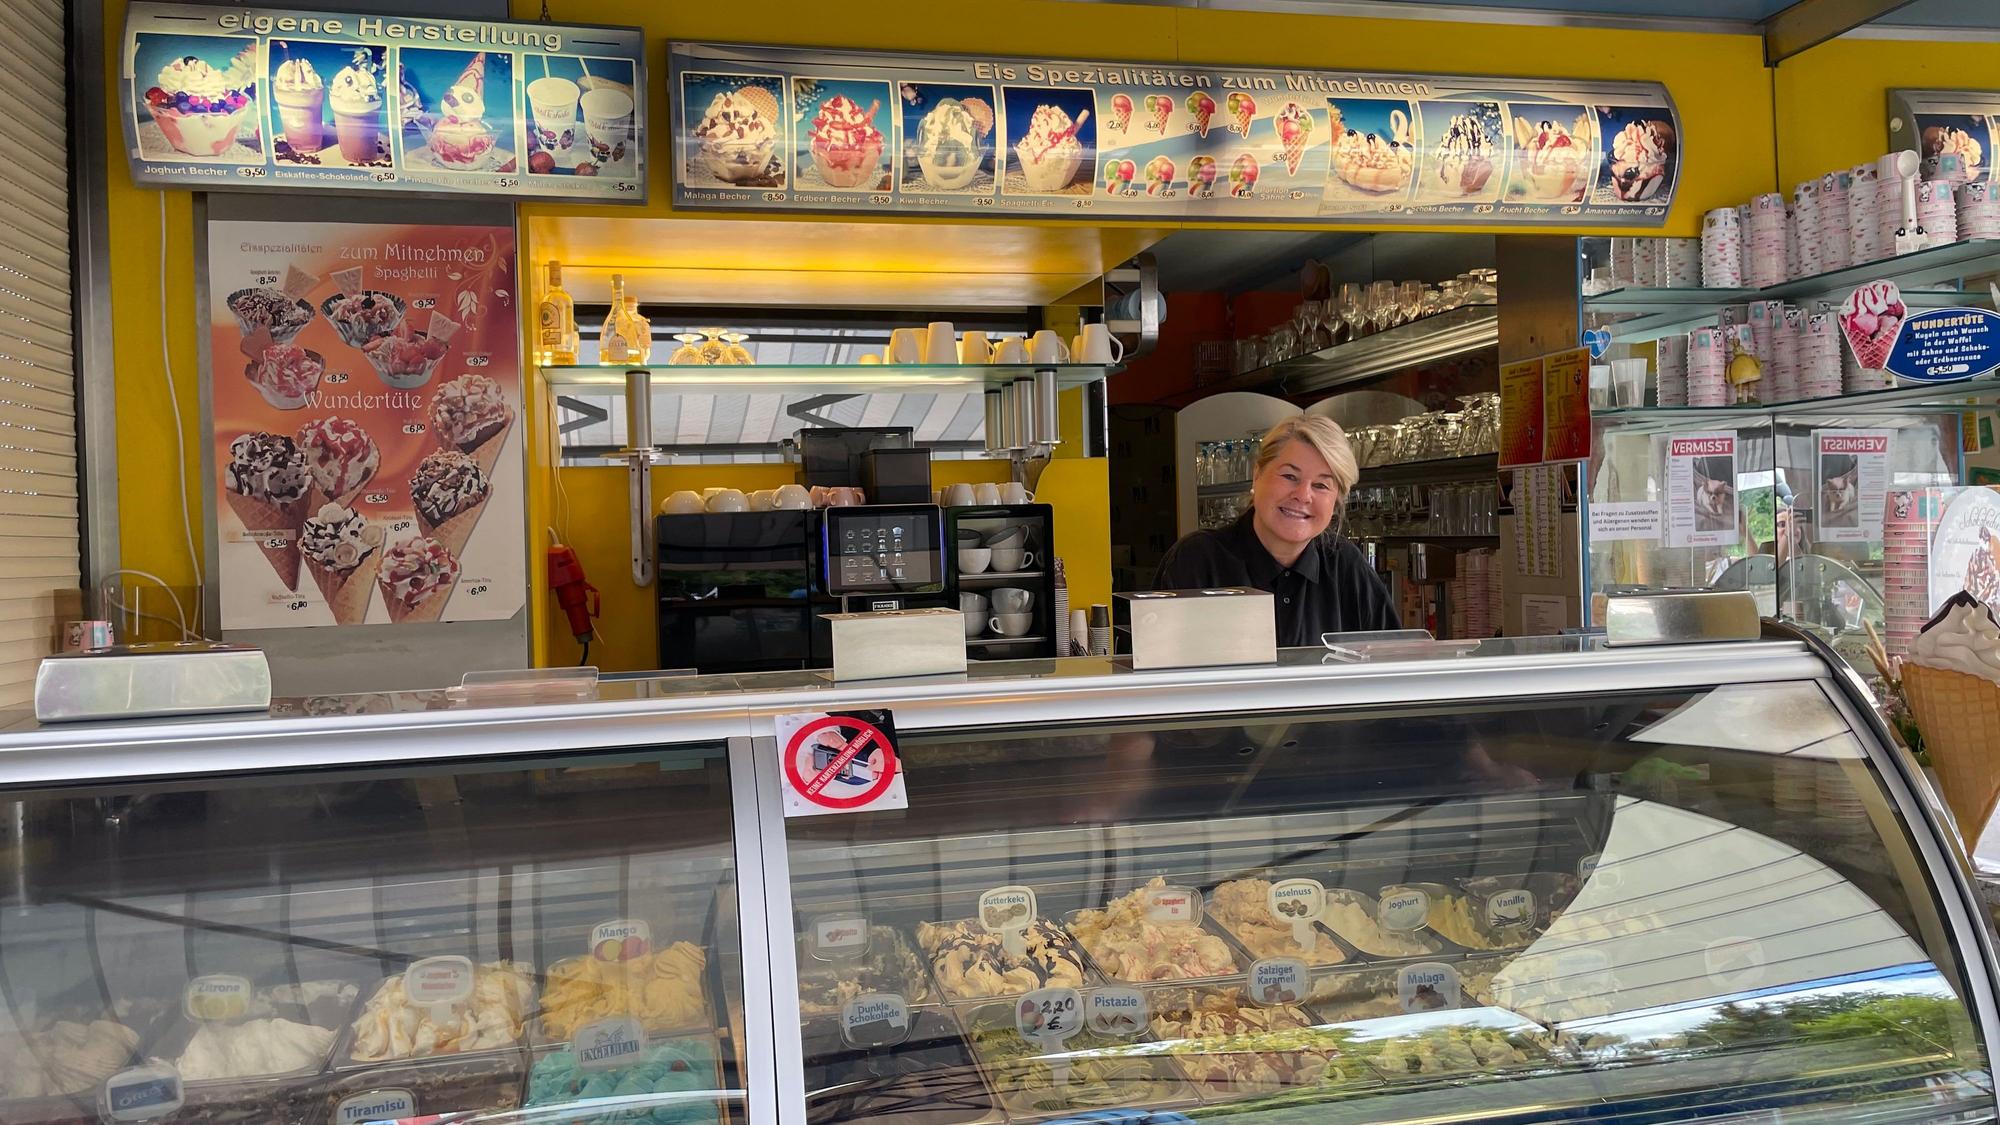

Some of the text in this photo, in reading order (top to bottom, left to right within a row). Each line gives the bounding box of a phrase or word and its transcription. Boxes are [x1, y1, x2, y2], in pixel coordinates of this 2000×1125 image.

[217, 11, 563, 52] eigene Herstellung
[973, 63, 1430, 95] Eis Spezialitäten zum Mitnehmen
[144, 165, 187, 177] Joghurt
[189, 166, 228, 176] Becher
[684, 191, 717, 201] Malaga
[719, 192, 751, 201] Becher
[794, 194, 828, 203] Erdbeer
[830, 195, 861, 204] Becher
[899, 197, 917, 205] Kiwi
[1499, 206, 1523, 214] Frucht
[1585, 207, 1616, 215] Amarena
[1618, 207, 1642, 215] Becher
[340, 246, 377, 260] zum
[385, 243, 485, 263] Mitnehmen
[375, 265, 438, 281] Spaghetti
[1912, 314, 1984, 330] WUNDERTÜTE
[1915, 331, 1939, 340] Kugeln
[1961, 325, 1989, 334] Wunsch
[1948, 336, 1972, 345] Waffel
[1921, 348, 1943, 356] Sahne
[1961, 344, 1990, 352] Schoko-
[1915, 354, 1981, 366] oder Erdbeersauce
[303, 390, 422, 411] Wundertüte
[1673, 440, 1730, 454] VERMISST
[807, 729, 874, 796] KEINE KARTENZAHLUNG MÖGLICH
[1388, 897, 1419, 910] Joghurt
[1496, 896, 1525, 908] Vanille
[599, 926, 637, 939] Mango
[1258, 966, 1292, 976] Salziges
[1257, 974, 1295, 985] Karamell
[1407, 972, 1445, 986] Malaga
[198, 982, 240, 993] Zitrone
[1094, 996, 1137, 1007] Pistazie
[858, 1001, 889, 1015] Dunkle
[848, 1008, 900, 1024] Schokolade
